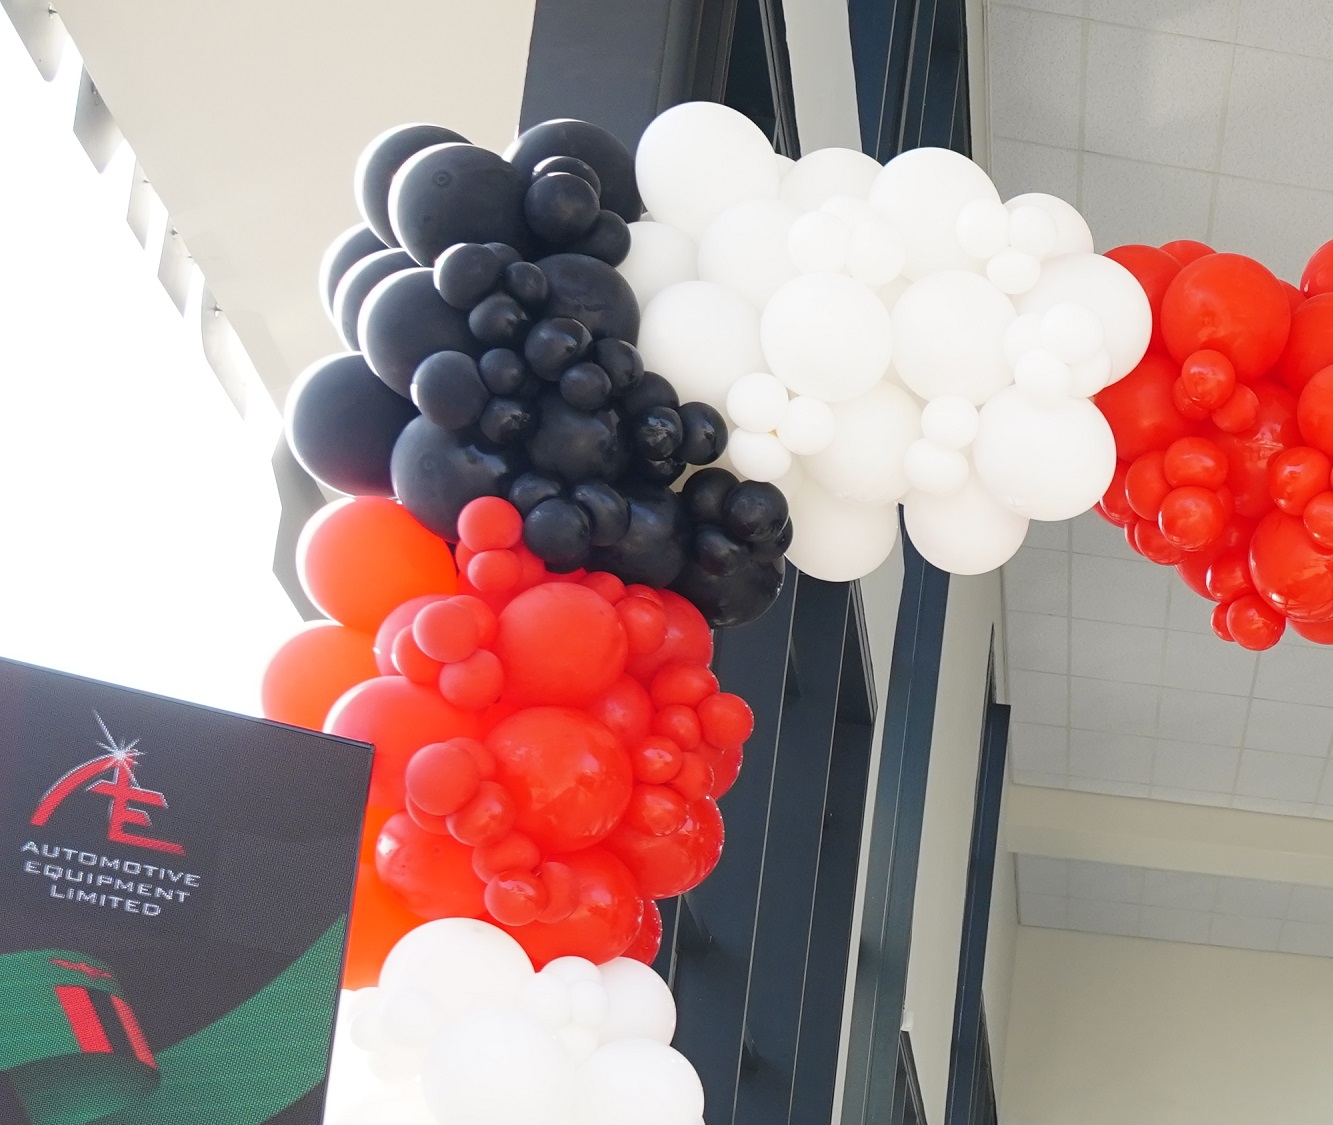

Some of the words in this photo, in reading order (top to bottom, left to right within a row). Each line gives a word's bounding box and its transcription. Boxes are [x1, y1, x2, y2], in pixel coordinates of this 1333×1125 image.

[20, 840, 201, 888] AUTOMOTIVE
[24, 860, 190, 903] EQUIPMENT
[50, 884, 162, 917] LIMITED
